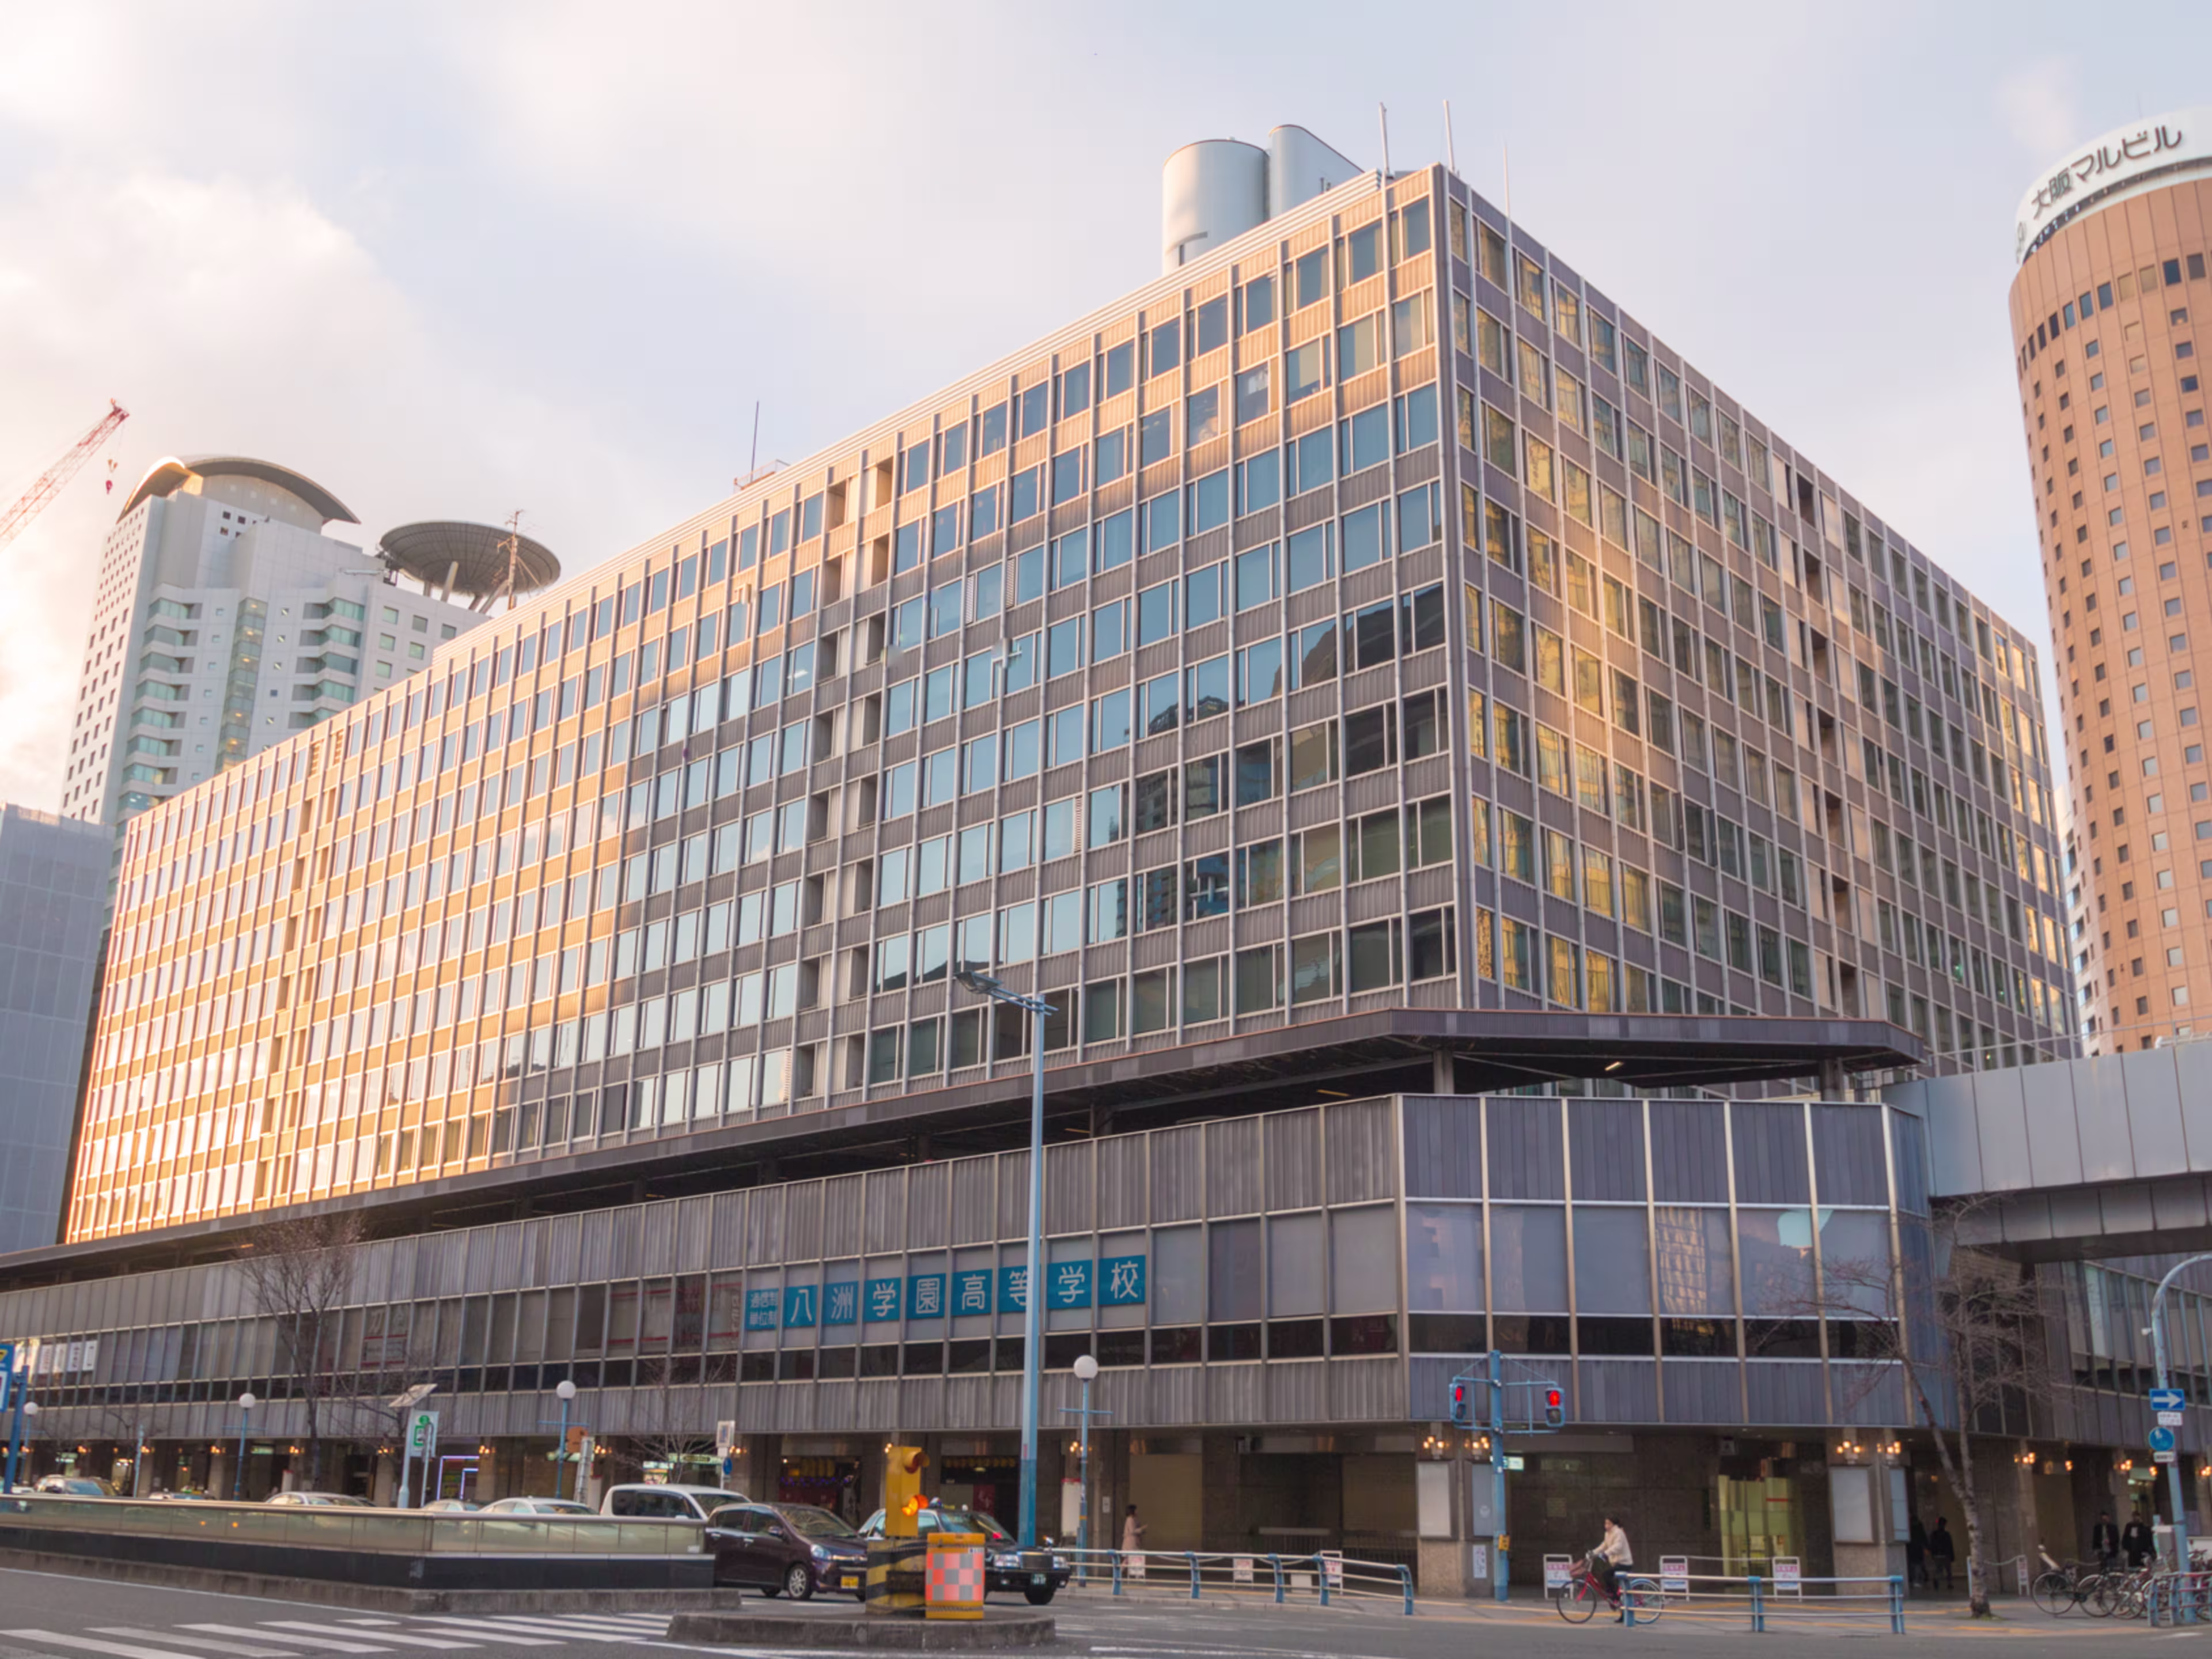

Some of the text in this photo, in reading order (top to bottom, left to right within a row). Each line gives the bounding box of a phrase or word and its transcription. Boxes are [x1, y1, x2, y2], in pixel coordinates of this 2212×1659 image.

[2031, 125, 2182, 220] 大阪マルビル
[790, 1261, 1138, 1323] 八洲学園高等学校
